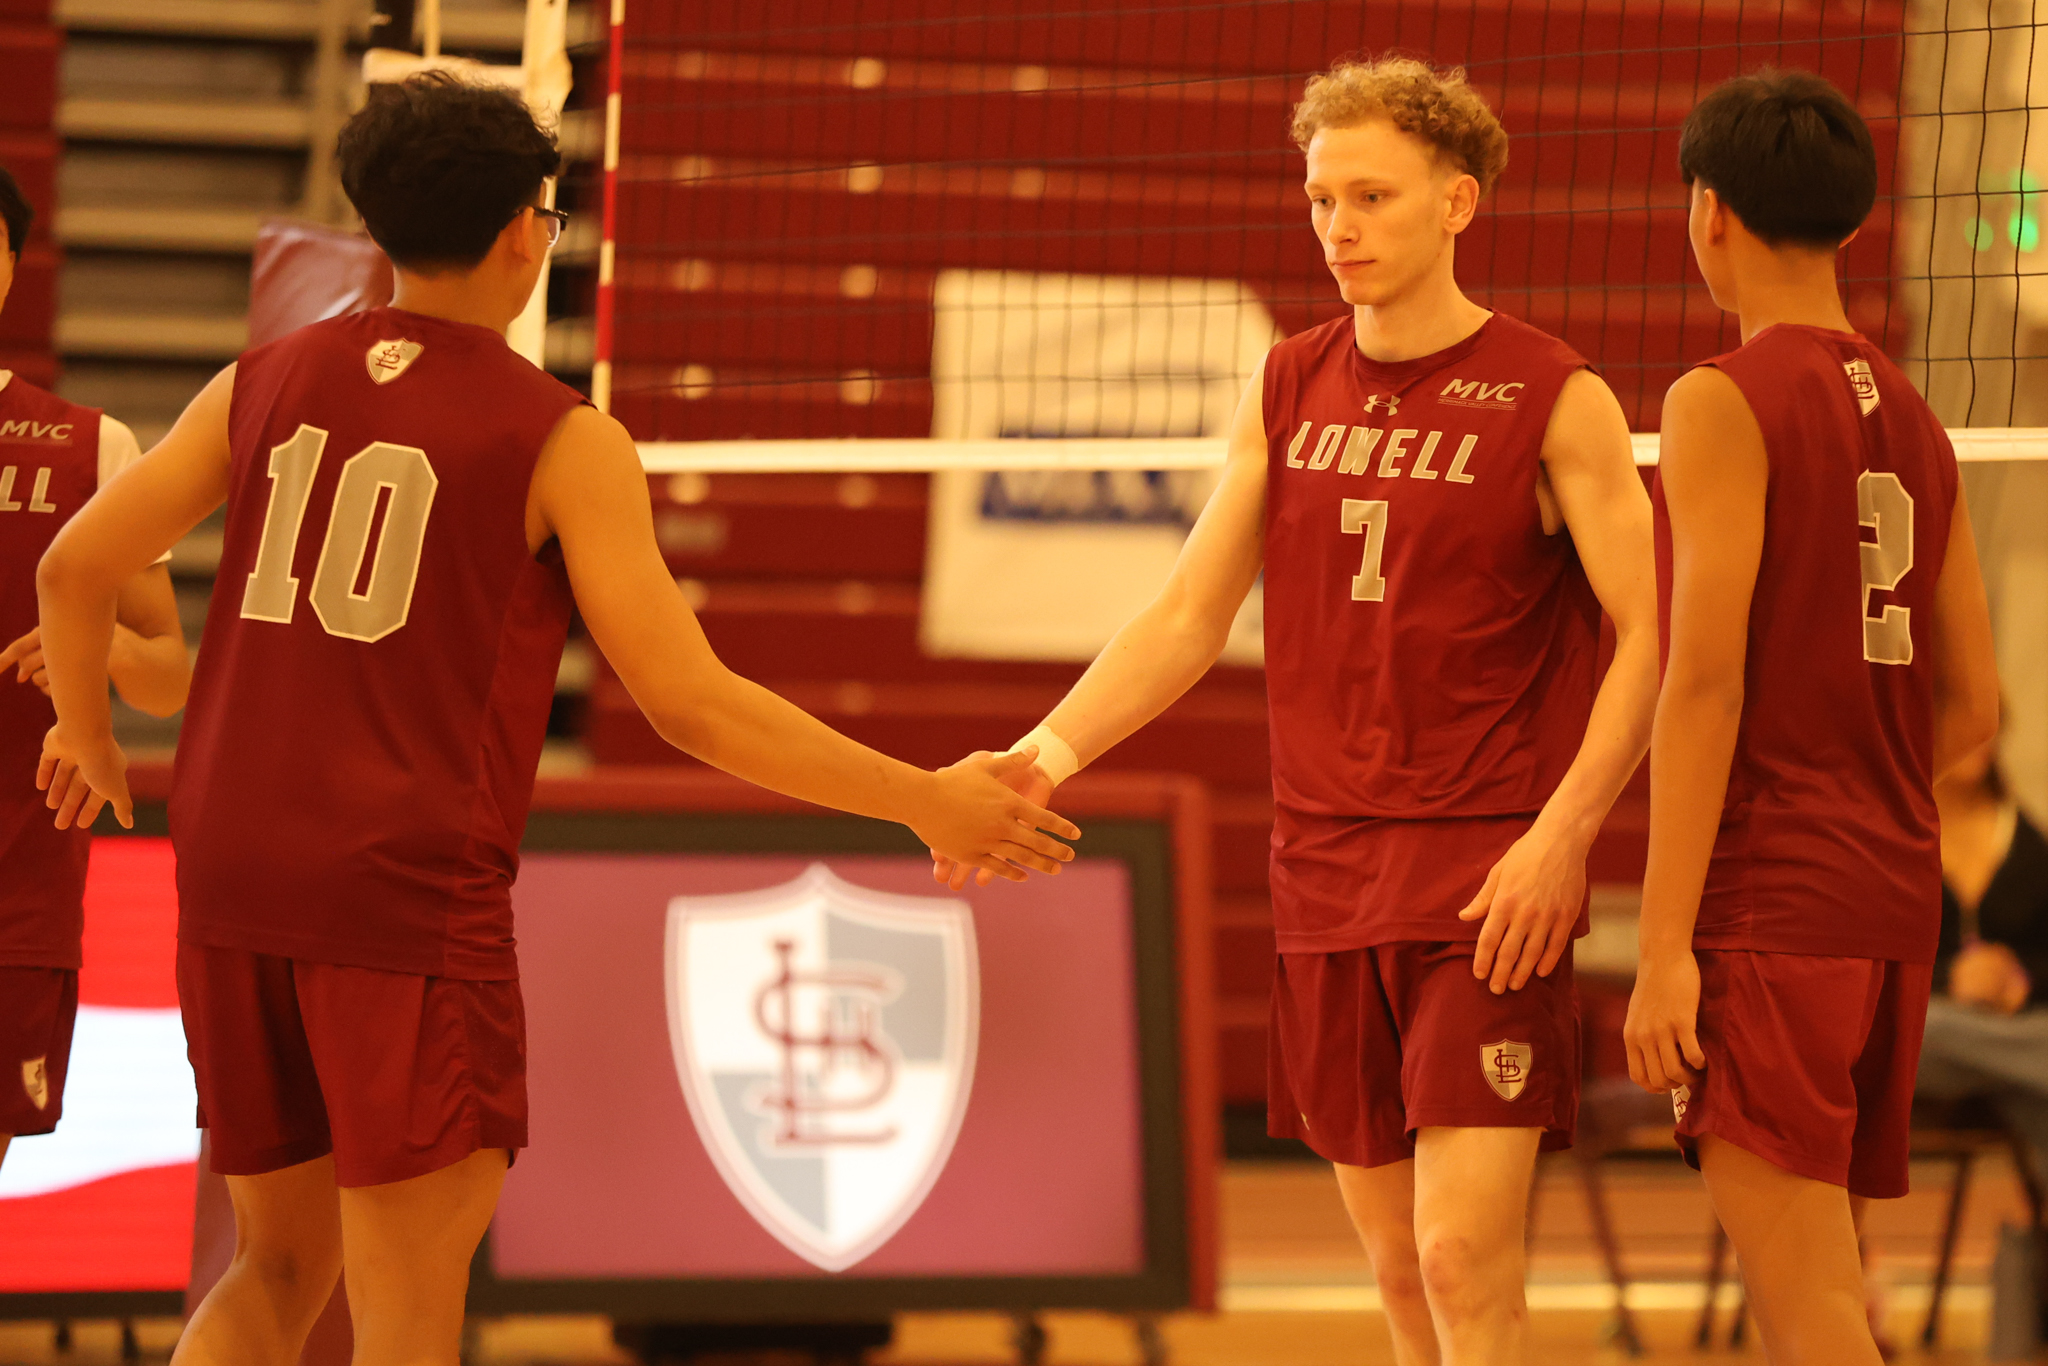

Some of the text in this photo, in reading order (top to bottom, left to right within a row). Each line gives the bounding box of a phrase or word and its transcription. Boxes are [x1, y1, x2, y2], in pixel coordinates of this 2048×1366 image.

[0, 420, 74, 440] MVC
[1440, 378, 1525, 402] MVC
[1287, 421, 1479, 484] LOWELL
[240, 423, 439, 643] 10
[1341, 498, 1389, 602] 7
[1857, 468, 1915, 666] 2
